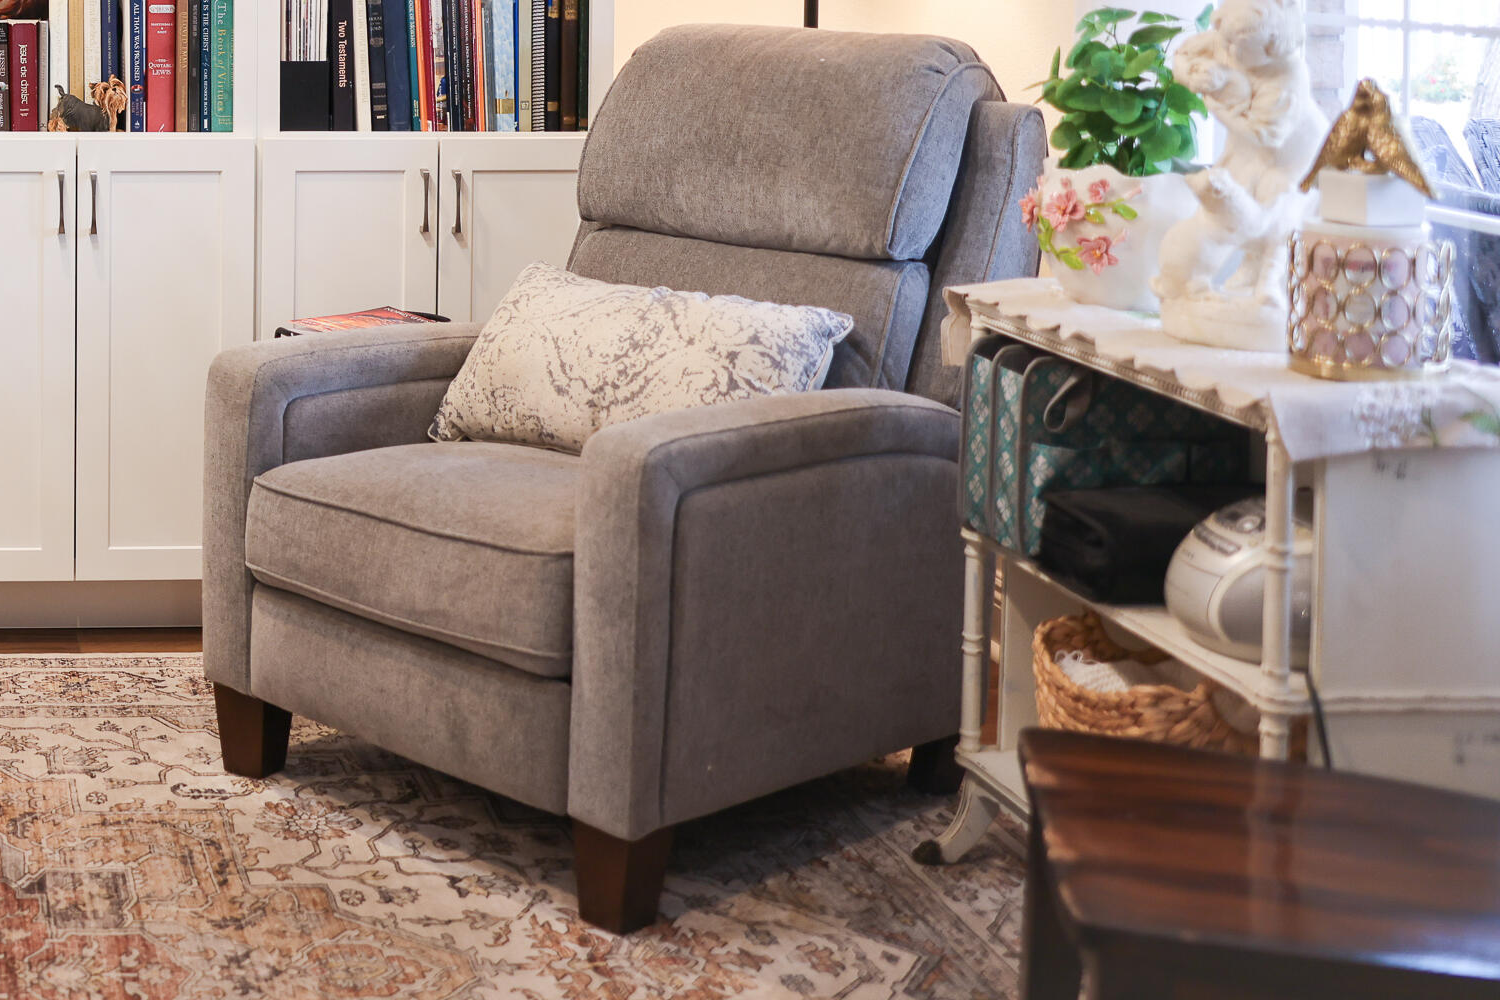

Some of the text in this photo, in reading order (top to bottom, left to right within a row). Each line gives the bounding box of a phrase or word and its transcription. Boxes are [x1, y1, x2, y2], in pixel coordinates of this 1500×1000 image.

[217, 2, 227, 24] The
[217, 29, 227, 57] Book
[338, 20, 347, 87] Two Testaments
[21, 80, 29, 104] Christ
[217, 72, 227, 112] Virtues
